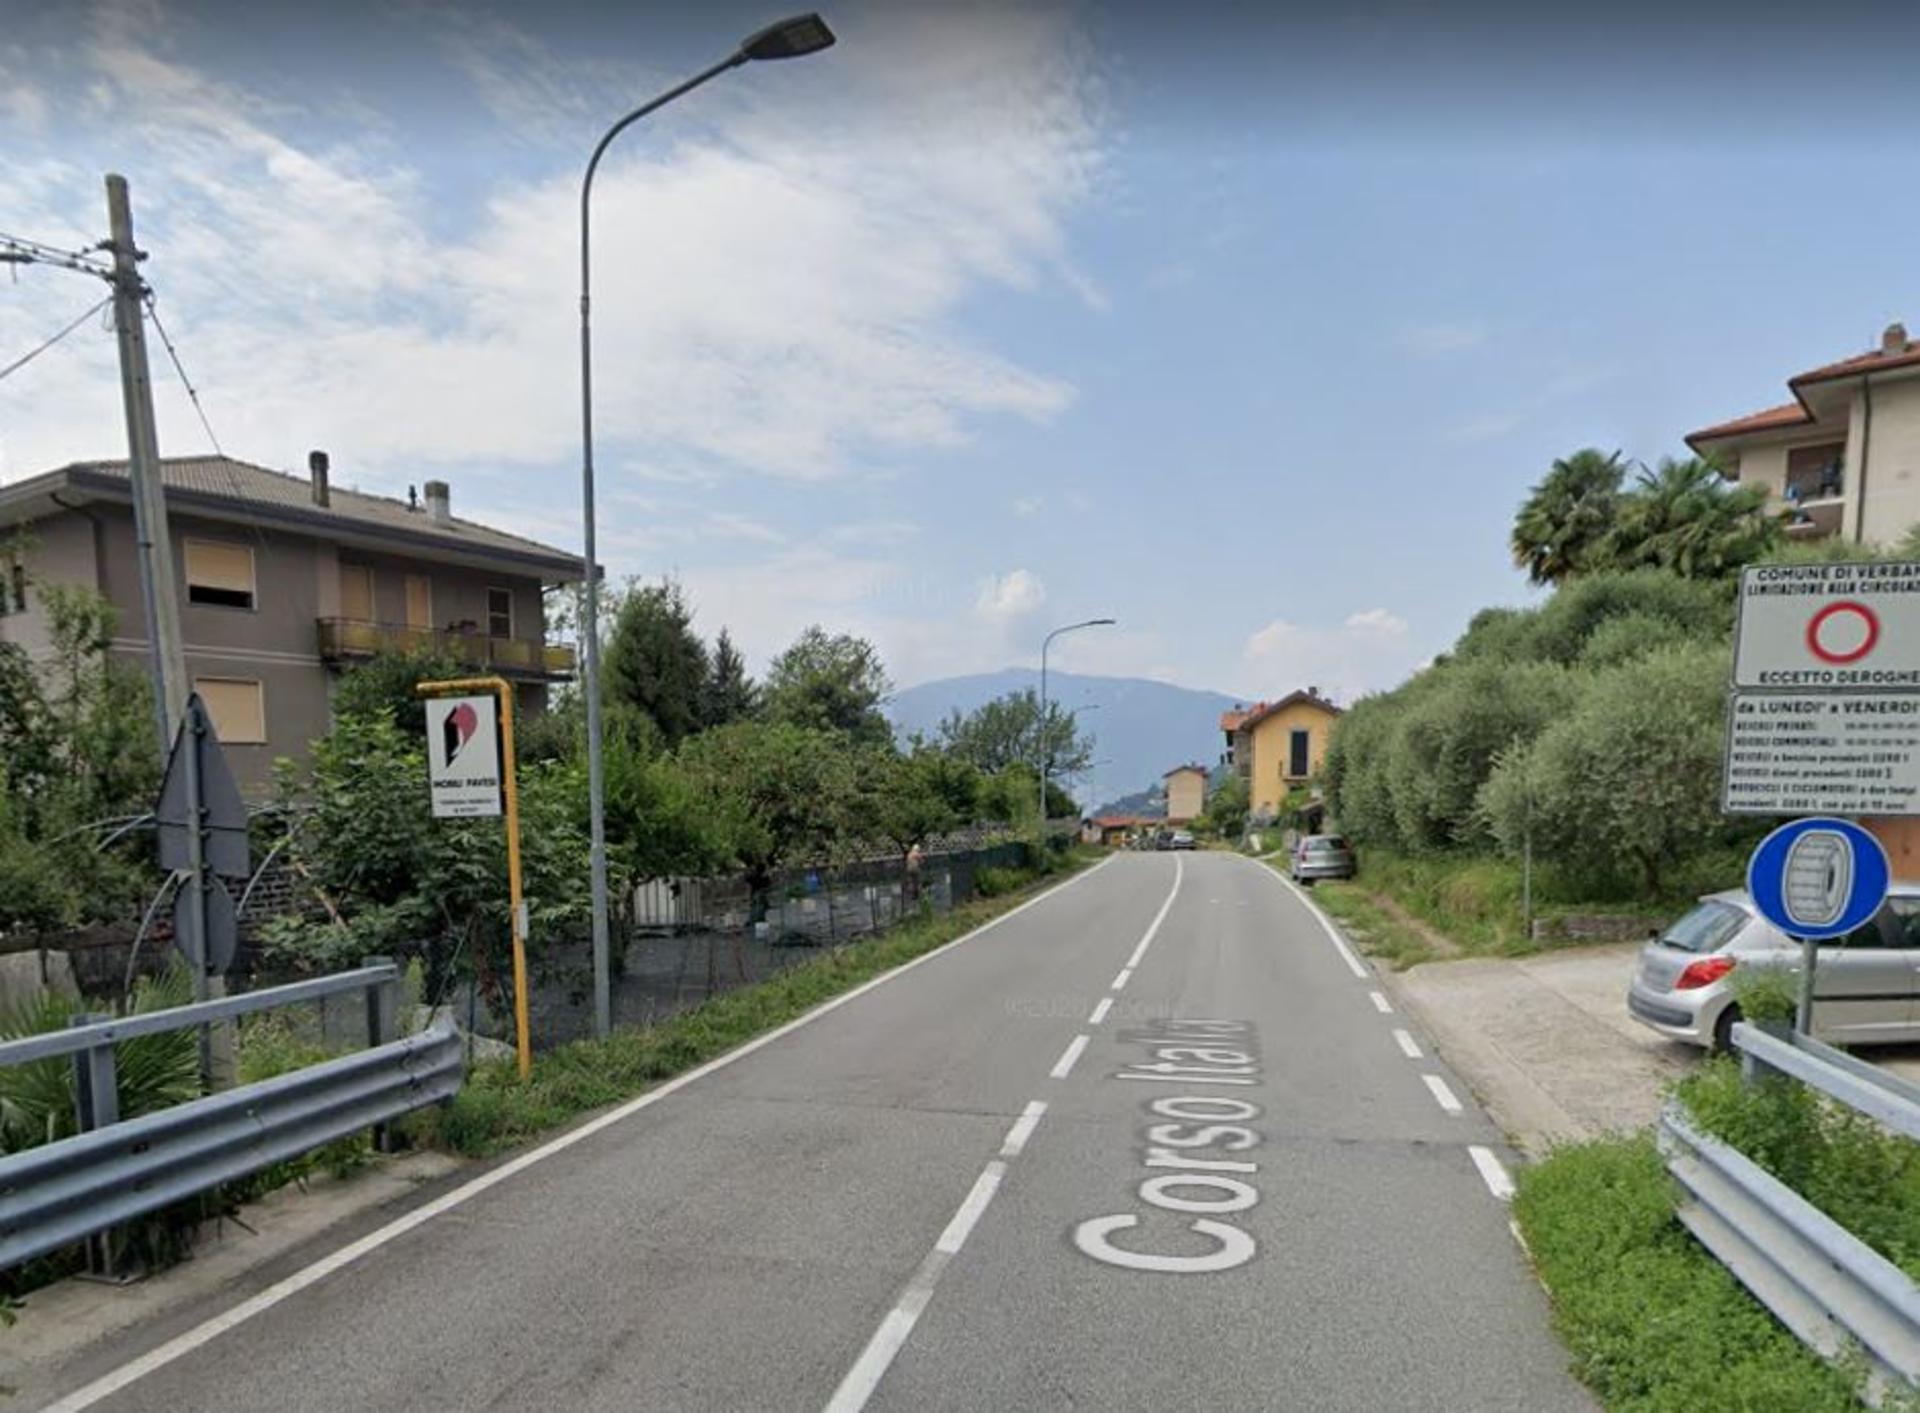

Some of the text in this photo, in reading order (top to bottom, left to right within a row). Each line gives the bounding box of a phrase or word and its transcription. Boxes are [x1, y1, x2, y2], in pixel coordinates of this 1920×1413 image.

[1758, 567, 1829, 581] COMUNE
[1835, 567, 1852, 579] DI
[1748, 582, 1825, 596] LIMITAZIONE
[1759, 670, 1920, 684] ECCETTO DEROGHE
[1738, 701, 1754, 714] da
